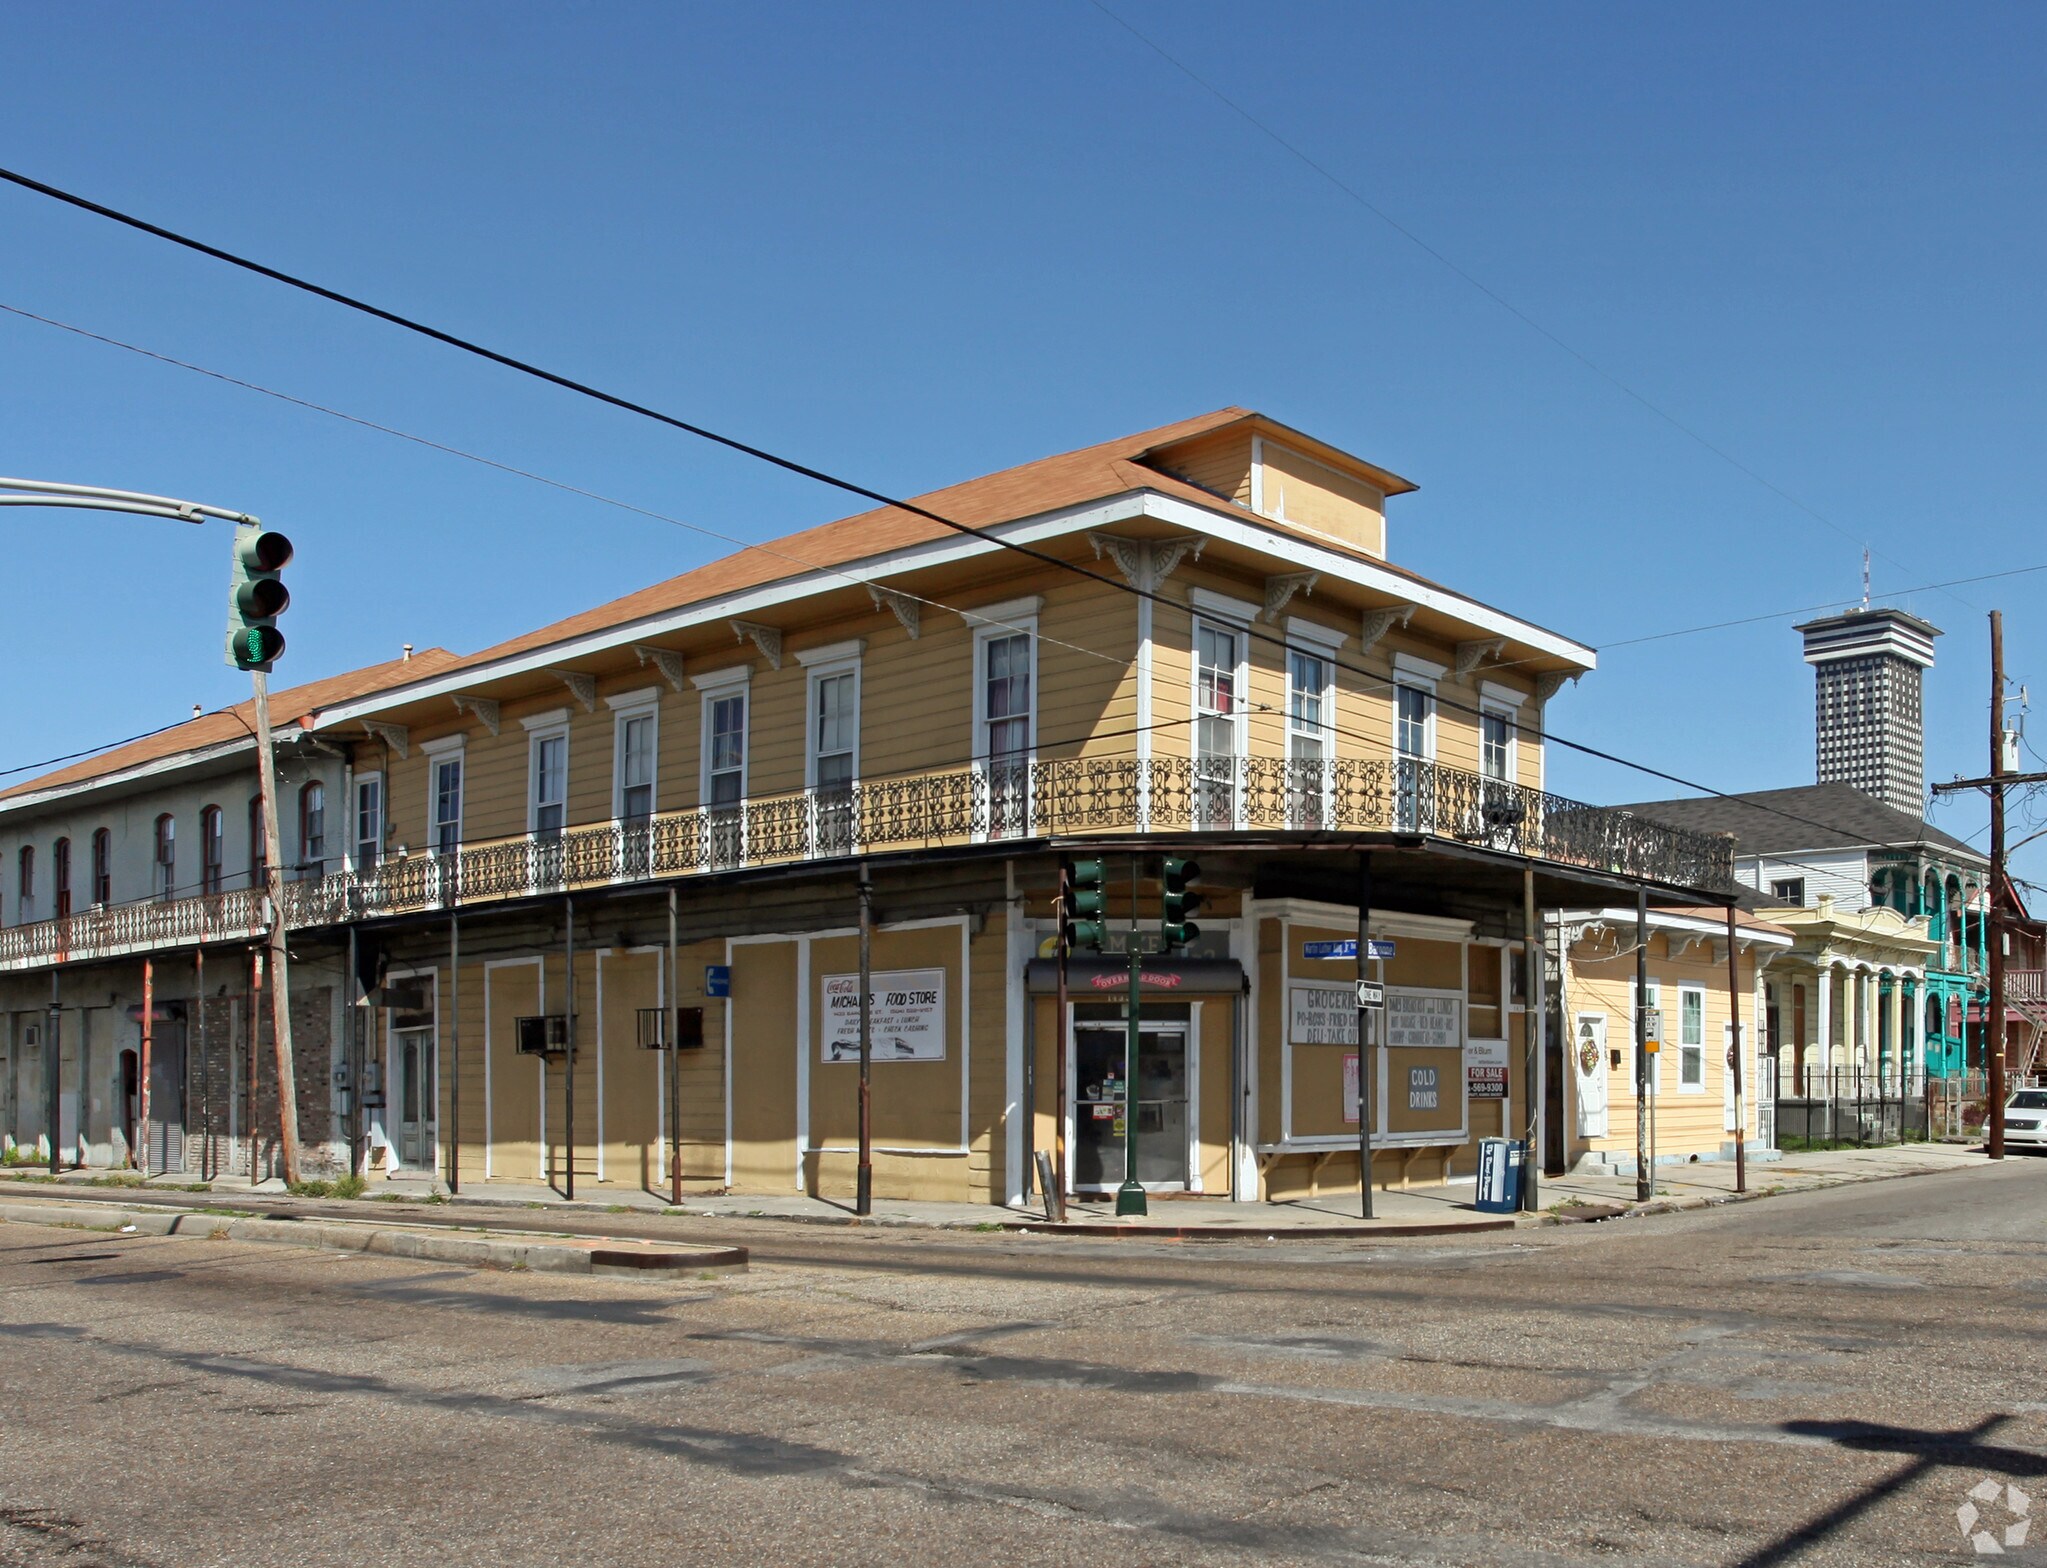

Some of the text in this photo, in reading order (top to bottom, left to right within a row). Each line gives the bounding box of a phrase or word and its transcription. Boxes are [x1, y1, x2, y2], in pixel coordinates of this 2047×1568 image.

[1101, 974, 1171, 988] OVERHD DOOR
[885, 992, 907, 1006] FOOD
[908, 991, 938, 1005] STORE
[1307, 990, 1357, 1010] GROCERIE
[869, 1017, 894, 1025] EAKFAST
[901, 1016, 920, 1024] LUNCH
[1329, 1012, 1348, 1027] FRIED
[1307, 1028, 1358, 1043] DELI TAKE OU
[1411, 1069, 1435, 1086] COLD
[1471, 1068, 1503, 1078] FOR SALE
[1468, 1083, 1503, 1092] -569-9300
[1410, 1091, 1437, 1108] DRINKS
